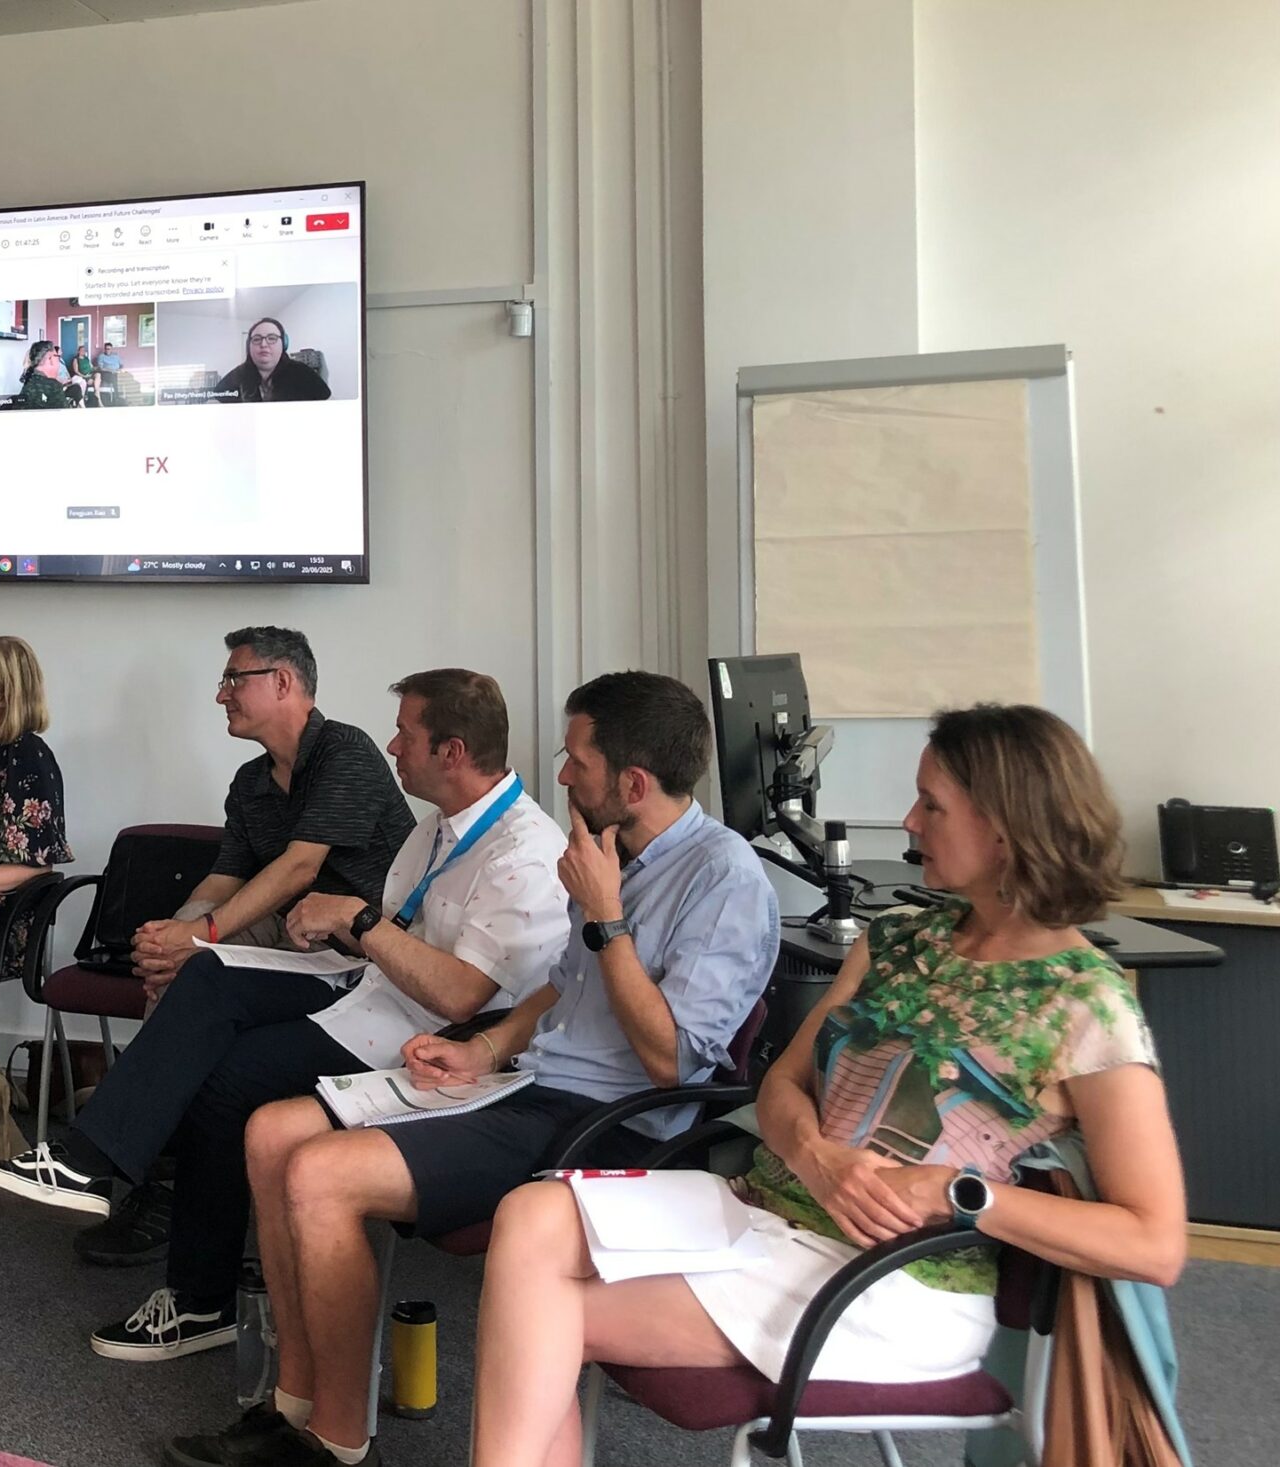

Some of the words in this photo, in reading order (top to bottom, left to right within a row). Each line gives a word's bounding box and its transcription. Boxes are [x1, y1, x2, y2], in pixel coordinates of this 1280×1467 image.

[98, 267, 124, 275] Recording
[136, 264, 170, 272] transcription
[84, 282, 107, 290] Started
[142, 279, 170, 287] everyone
[182, 287, 204, 295] Privacy
[205, 286, 225, 294] policy
[146, 456, 168, 474] FX
[162, 561, 183, 570] Mostly
[184, 561, 206, 570] cloudy
